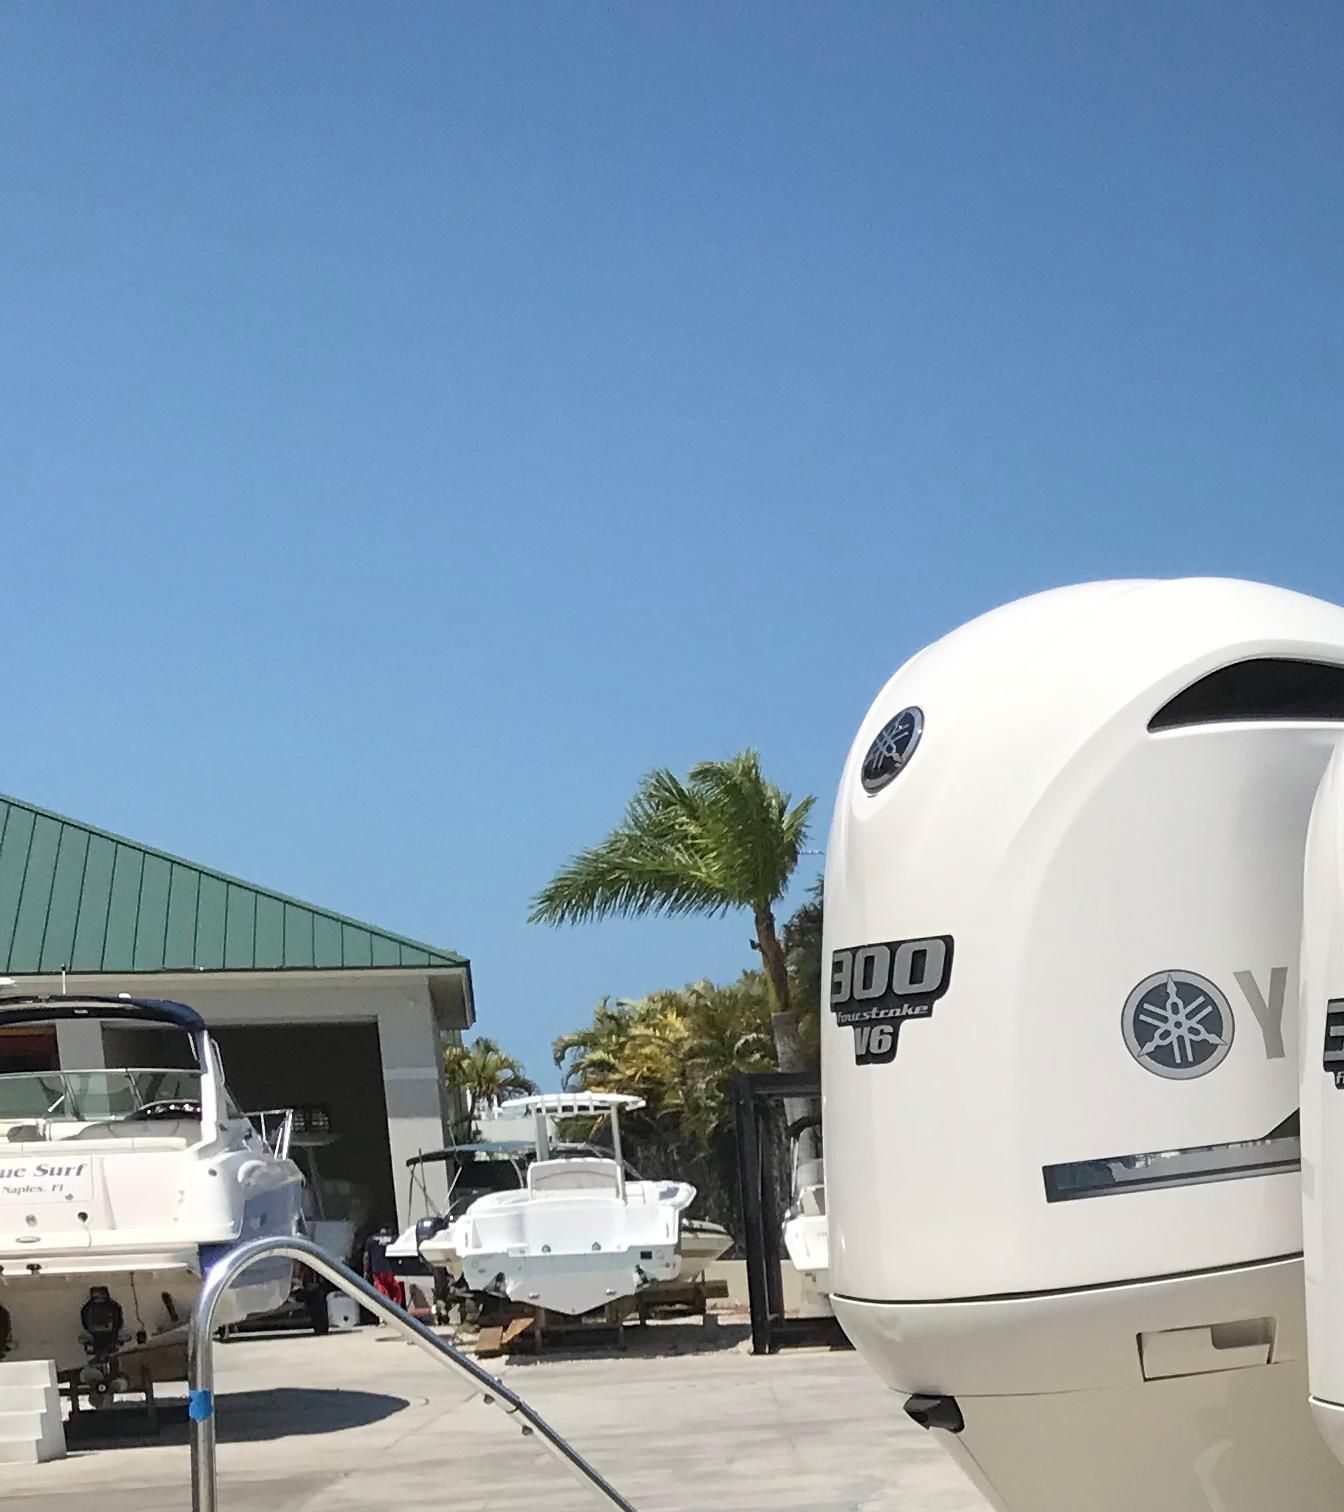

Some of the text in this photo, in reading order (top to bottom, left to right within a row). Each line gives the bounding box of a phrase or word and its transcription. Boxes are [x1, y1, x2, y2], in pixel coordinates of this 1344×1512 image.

[831, 938, 946, 1004] 300
[854, 1024, 894, 1056] V6
[33, 1162, 88, 1177] Surf
